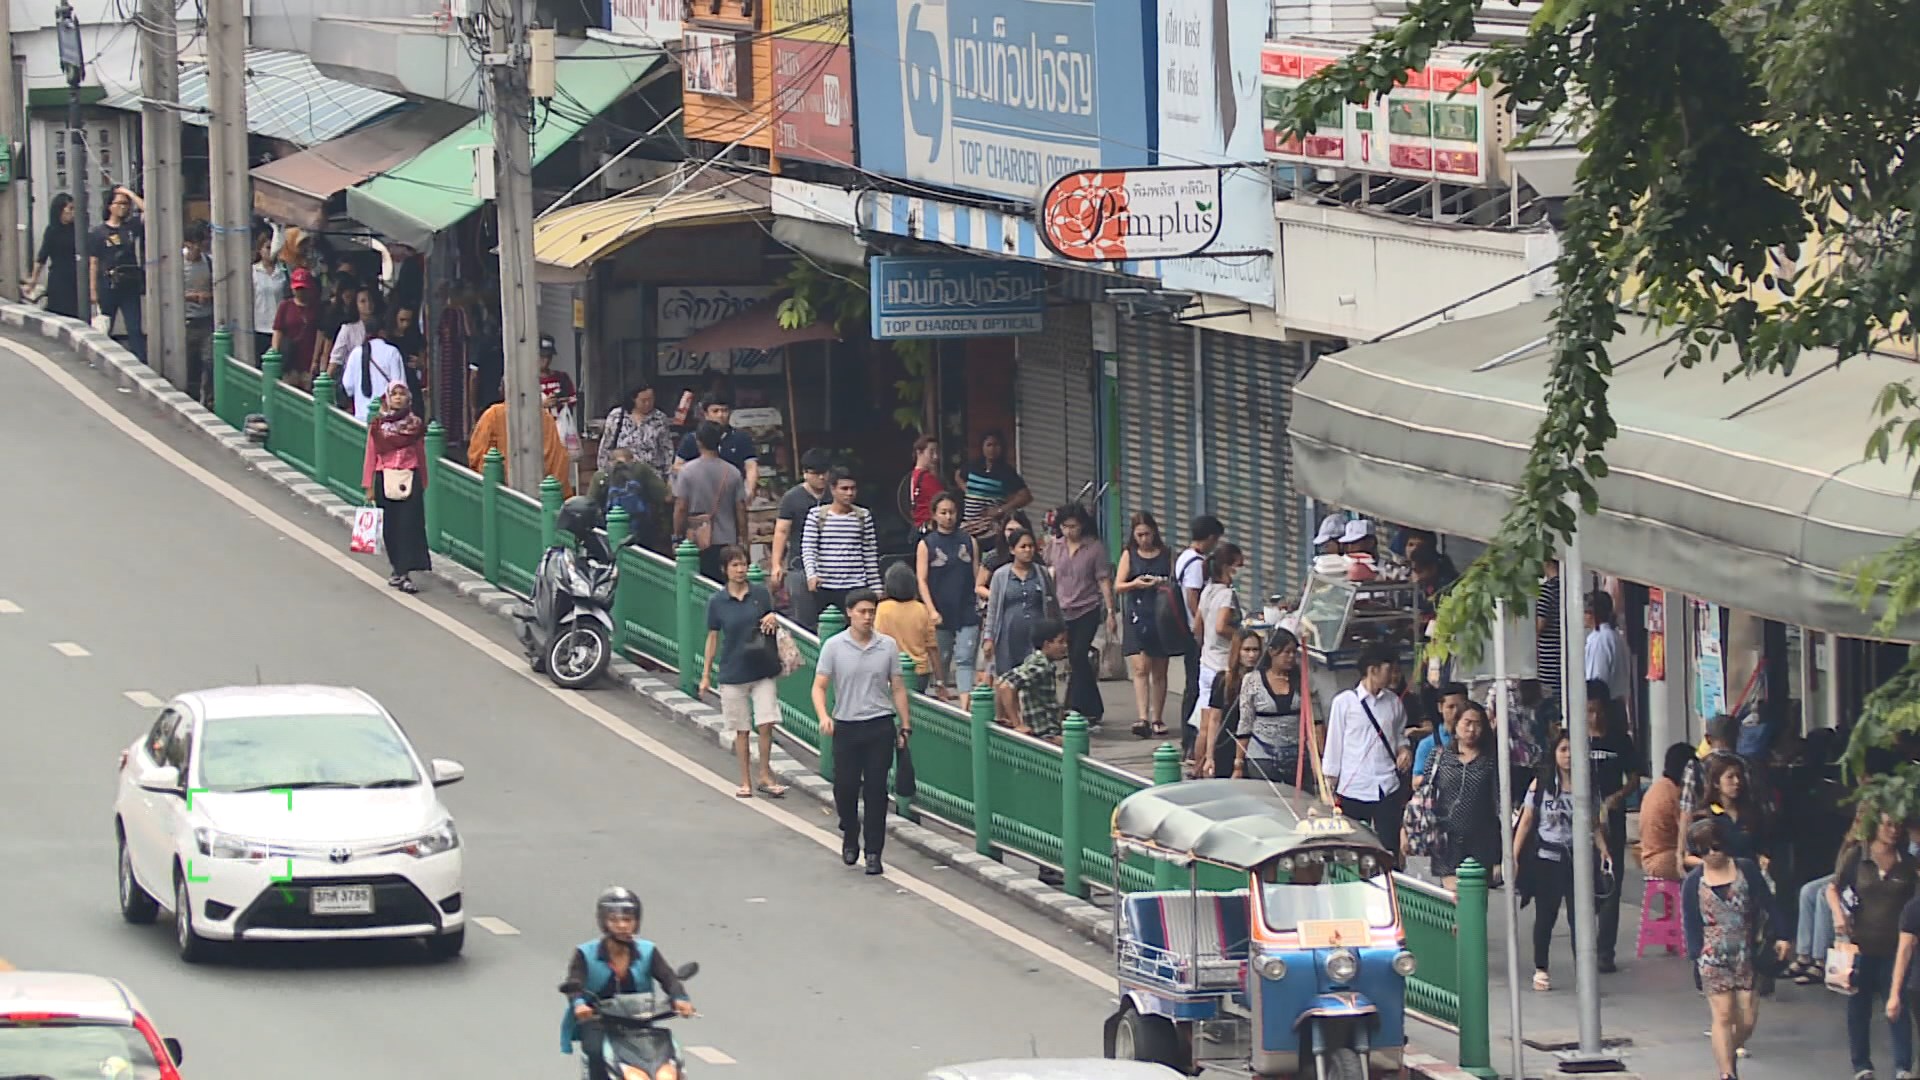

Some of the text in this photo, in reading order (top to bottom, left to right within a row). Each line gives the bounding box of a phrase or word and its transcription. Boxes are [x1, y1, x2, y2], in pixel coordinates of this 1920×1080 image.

[959, 139, 982, 176] TOP
[986, 144, 1043, 187] CHAROEN
[1051, 186, 1213, 246] Pimplus
[885, 317, 1036, 333] TOP CHAROEN OPTICAL
[1309, 820, 1342, 831] TAXI
